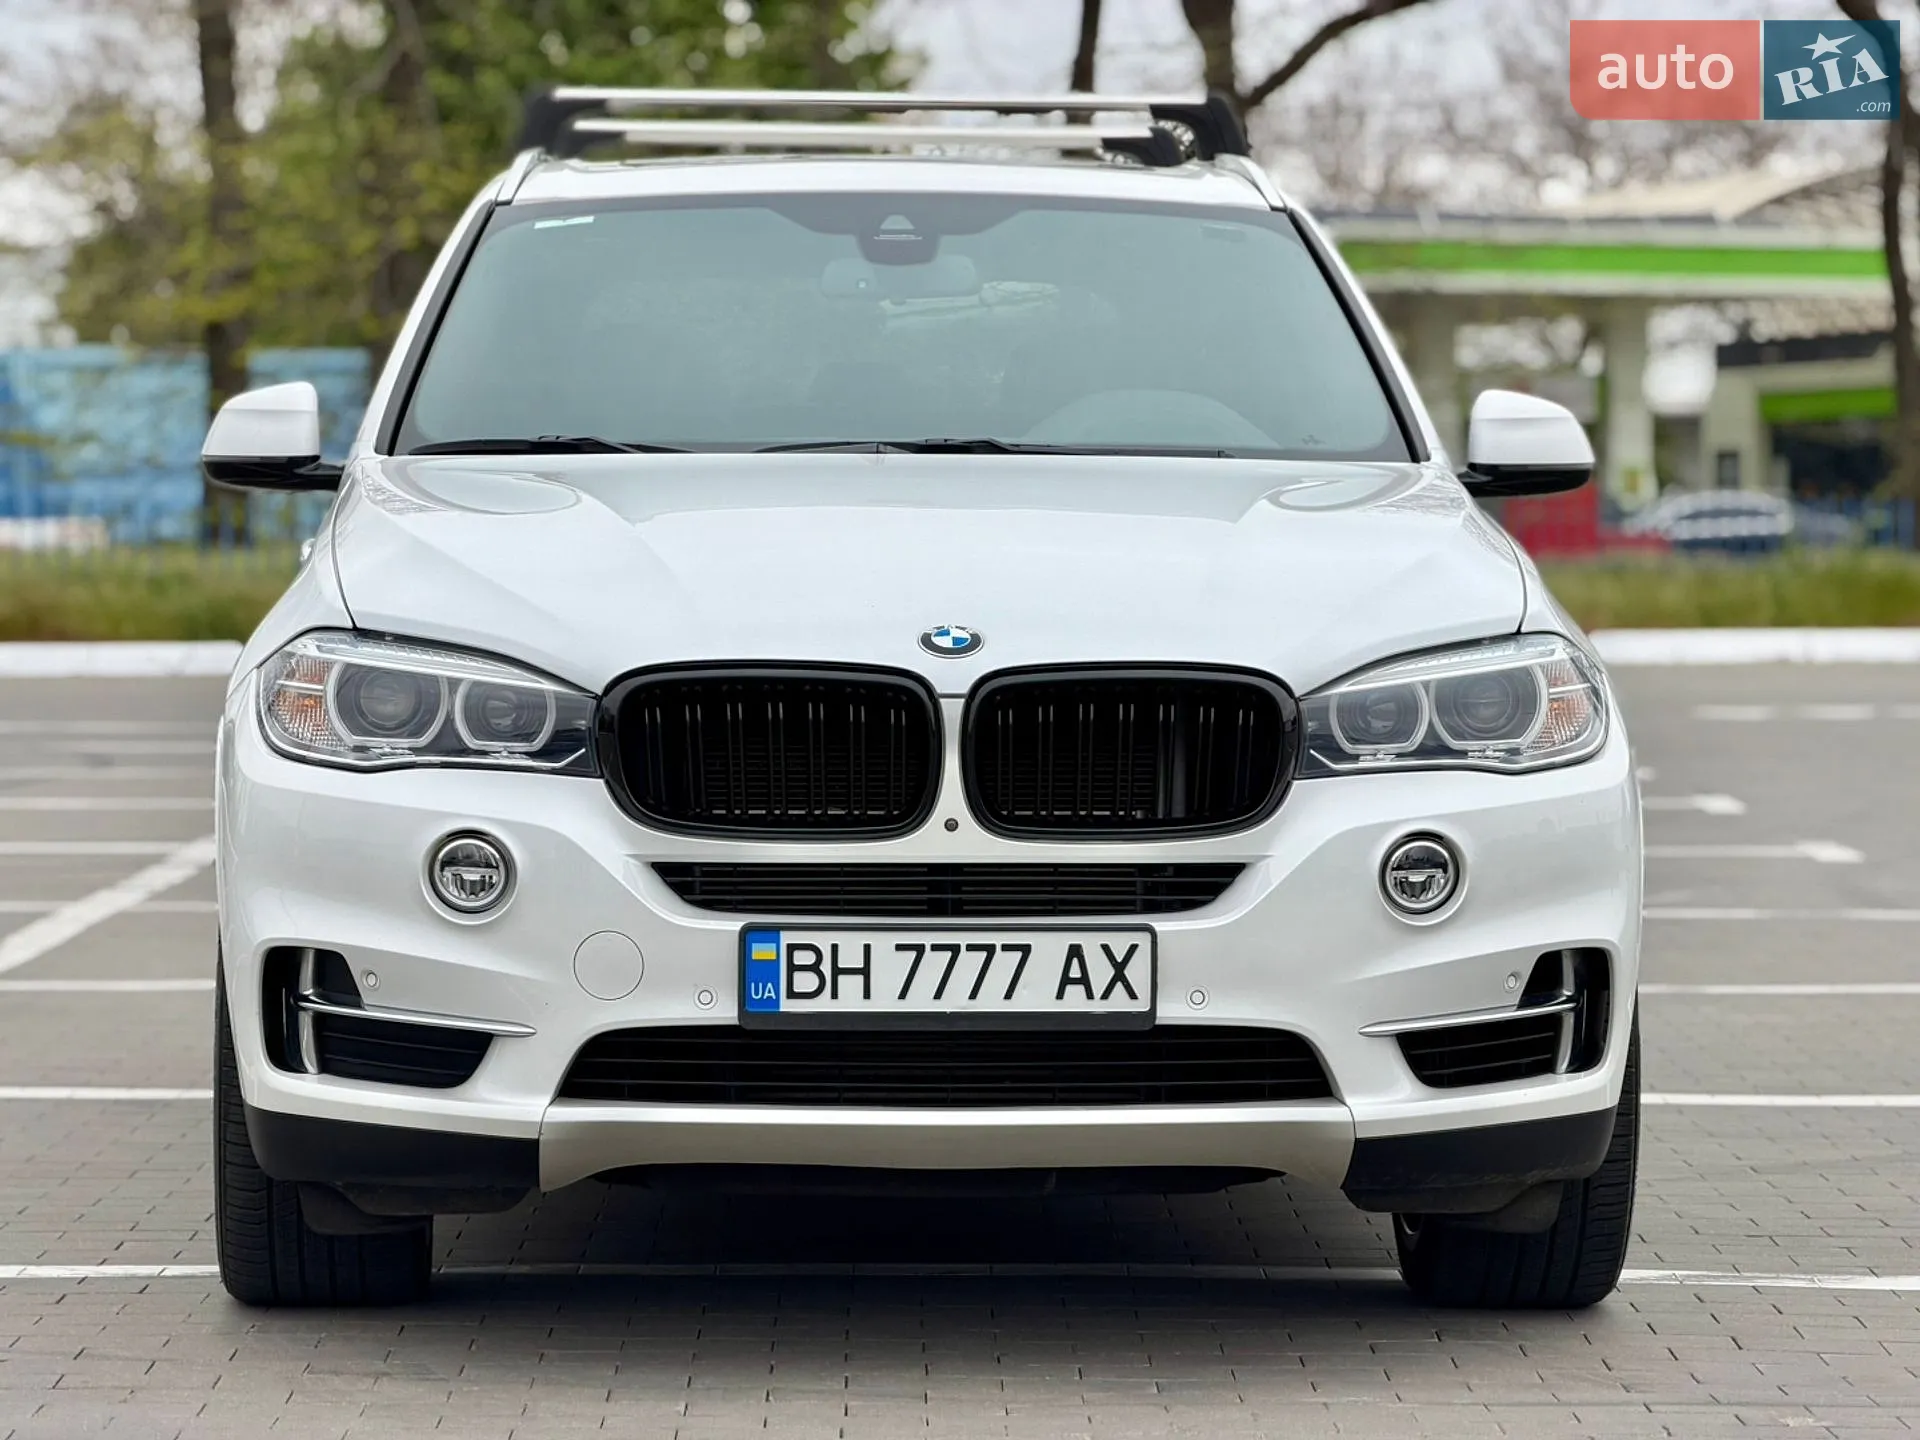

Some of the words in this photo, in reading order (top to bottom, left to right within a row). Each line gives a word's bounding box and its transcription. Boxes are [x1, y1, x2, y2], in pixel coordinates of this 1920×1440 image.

[785, 943, 871, 1000] BH
[895, 943, 1032, 1000] 7777
[1055, 943, 1140, 1000] AX
[751, 983, 777, 1000] UA
